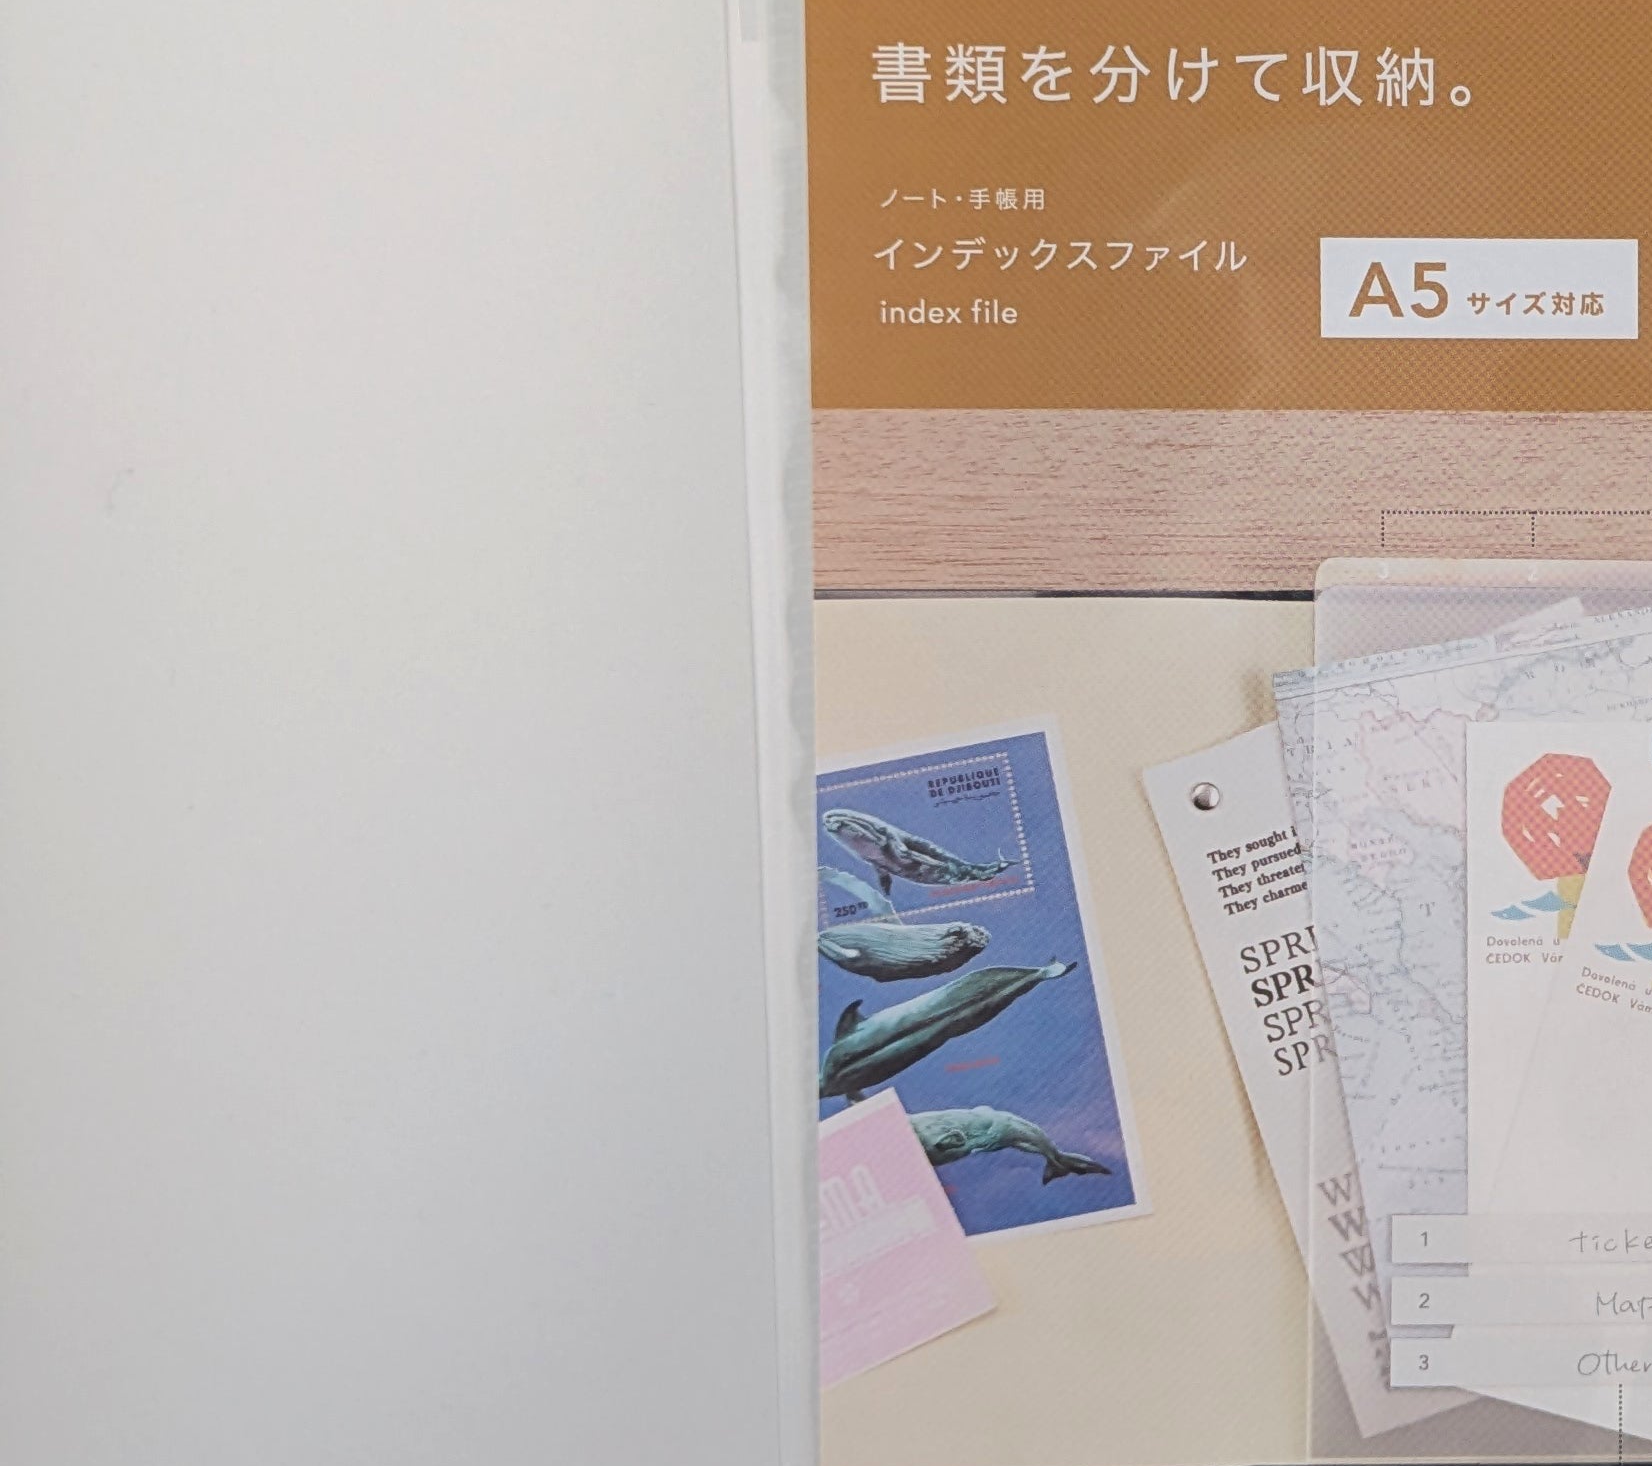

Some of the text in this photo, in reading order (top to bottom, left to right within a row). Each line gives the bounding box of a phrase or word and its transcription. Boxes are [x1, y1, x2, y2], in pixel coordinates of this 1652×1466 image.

[871, 41, 1473, 108] 書類を分けて収納。
[879, 187, 1047, 212] ノート・手帳用
[873, 239, 1248, 273] インデックスファイル
[1348, 261, 1605, 320] A5 サイズ対応
[879, 298, 1019, 326] index file
[1206, 846, 1241, 864] They
[1245, 830, 1288, 853] sought
[1211, 842, 1302, 882] They pursued
[1218, 880, 1252, 899] They
[1223, 897, 1258, 916] They
[1420, 1231, 1430, 1248] 1
[1418, 1293, 1431, 1309] 2
[1418, 1354, 1430, 1371] 3
